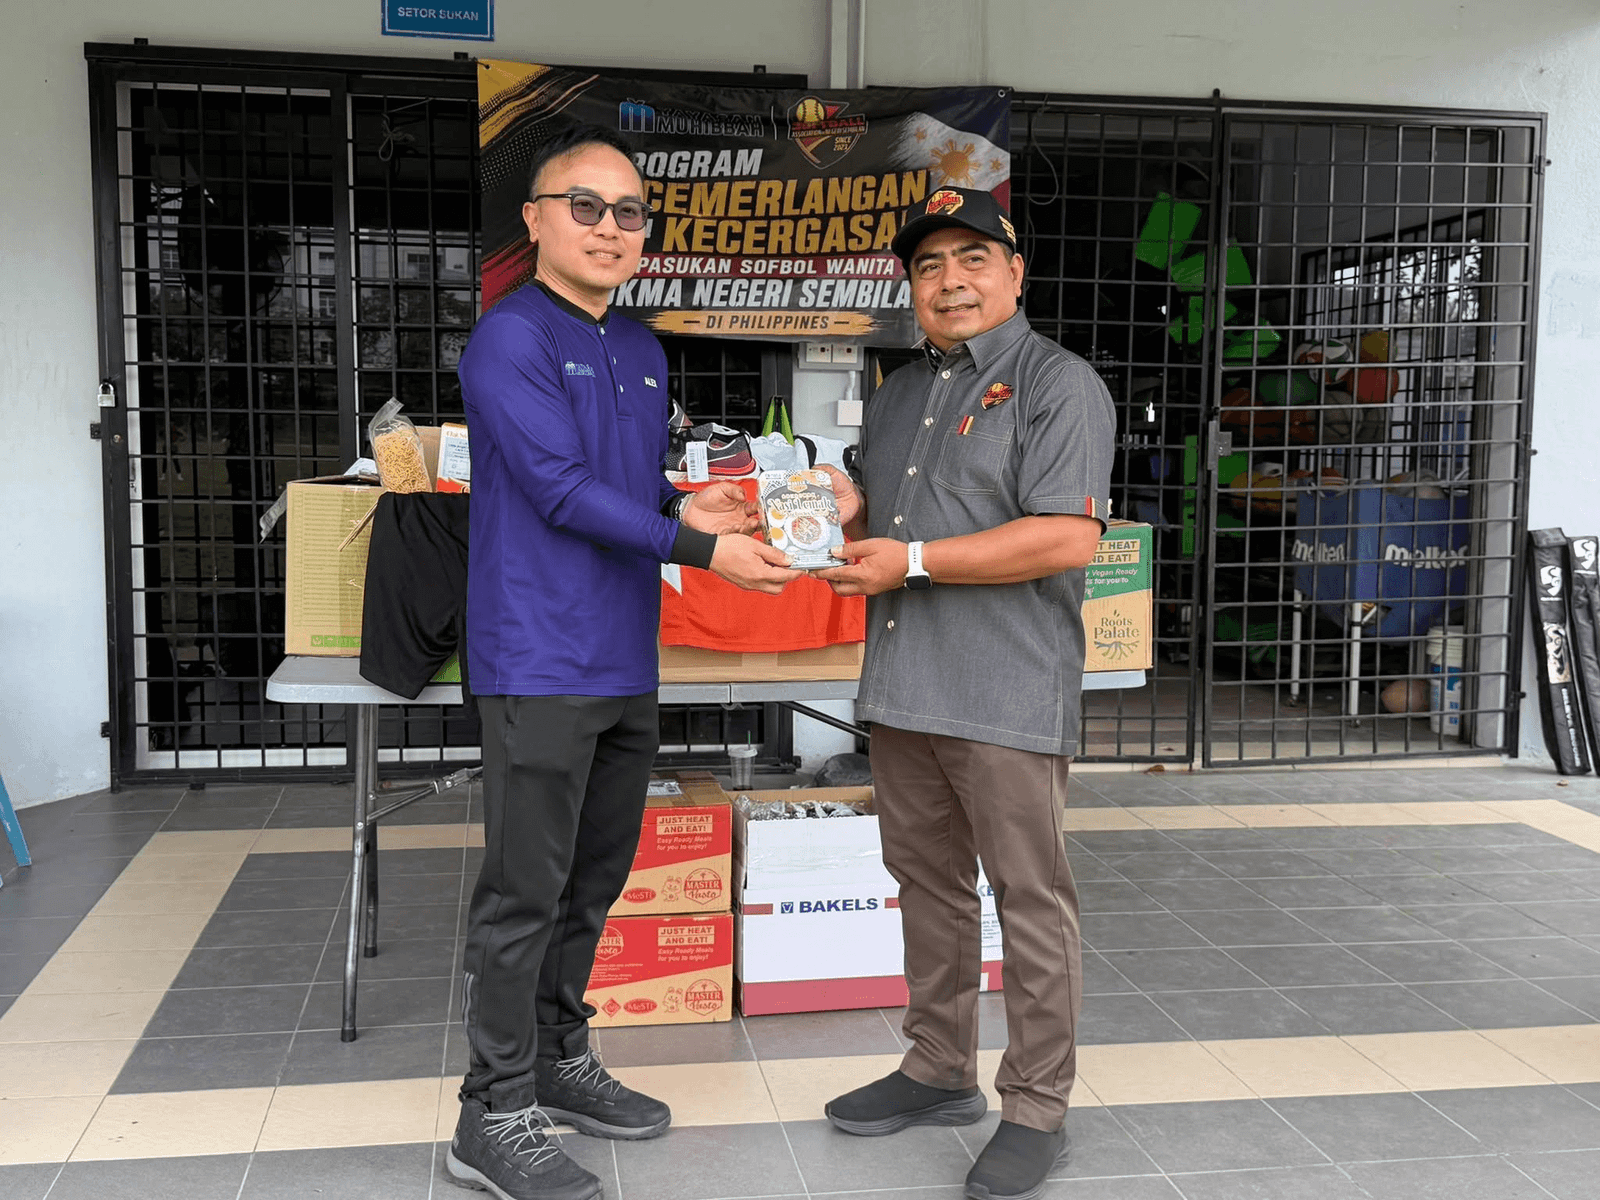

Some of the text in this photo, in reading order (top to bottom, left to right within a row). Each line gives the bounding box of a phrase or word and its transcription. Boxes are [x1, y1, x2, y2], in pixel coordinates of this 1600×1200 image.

[397, 6, 479, 21] SETOR SUKAN
[657, 114, 765, 138] MUHIBBAH
[634, 149, 764, 178] ROGRAM
[644, 169, 927, 217] CEMERLANGAN
[662, 210, 907, 254] KECERGASA
[636, 256, 896, 275] PASUKAN SOFBOL WANITA
[608, 278, 914, 309] KMA NEGERI SEMBILA
[706, 315, 830, 330] DI PHILIPPINES
[1108, 541, 1138, 550] HEAT
[1091, 556, 1104, 564] ND
[1092, 568, 1114, 578] Vegan
[1115, 567, 1138, 576] Ready
[1101, 617, 1133, 627] Roots
[1094, 627, 1140, 639] Palate
[659, 815, 710, 824] JUST HEAT
[686, 880, 720, 889] MASTER
[799, 898, 878, 913] BAKELS
[687, 991, 721, 1001] MASTER
